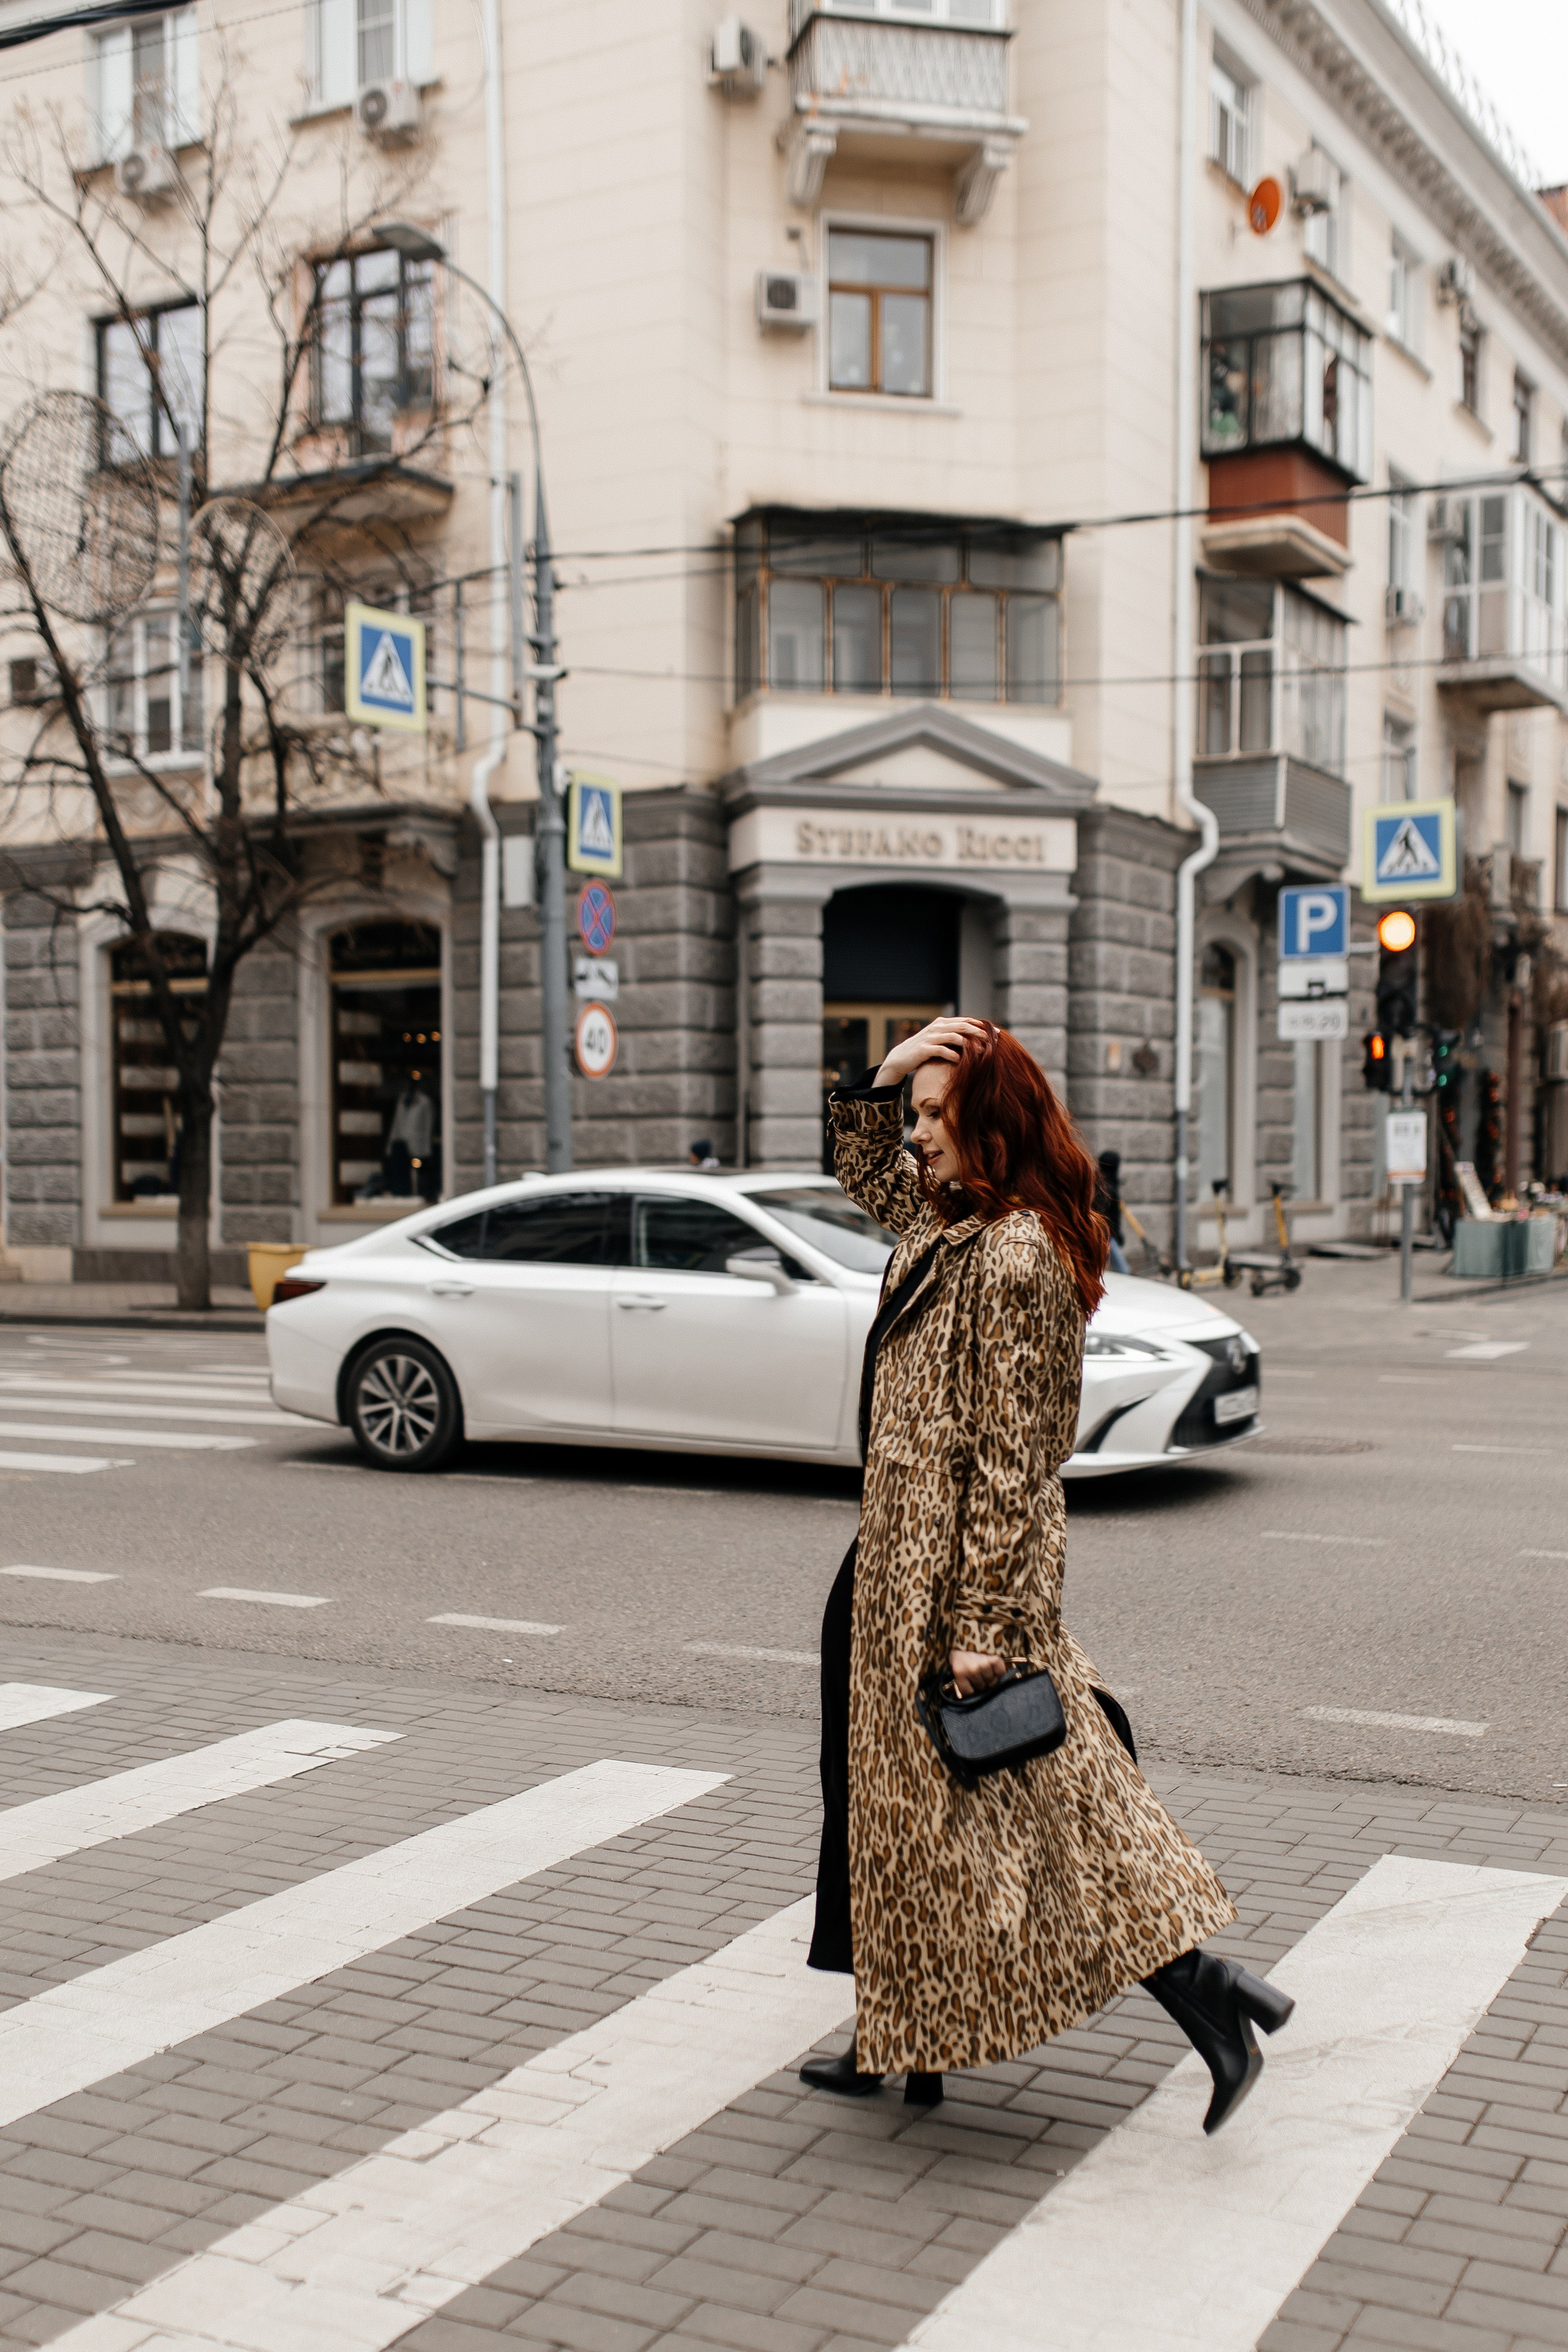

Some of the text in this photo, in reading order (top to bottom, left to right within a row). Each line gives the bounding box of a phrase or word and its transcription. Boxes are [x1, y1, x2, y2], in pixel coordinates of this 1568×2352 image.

[957, 827, 1044, 862] RICCI
[1296, 894, 1338, 952] P
[586, 1027, 608, 1055] 40
